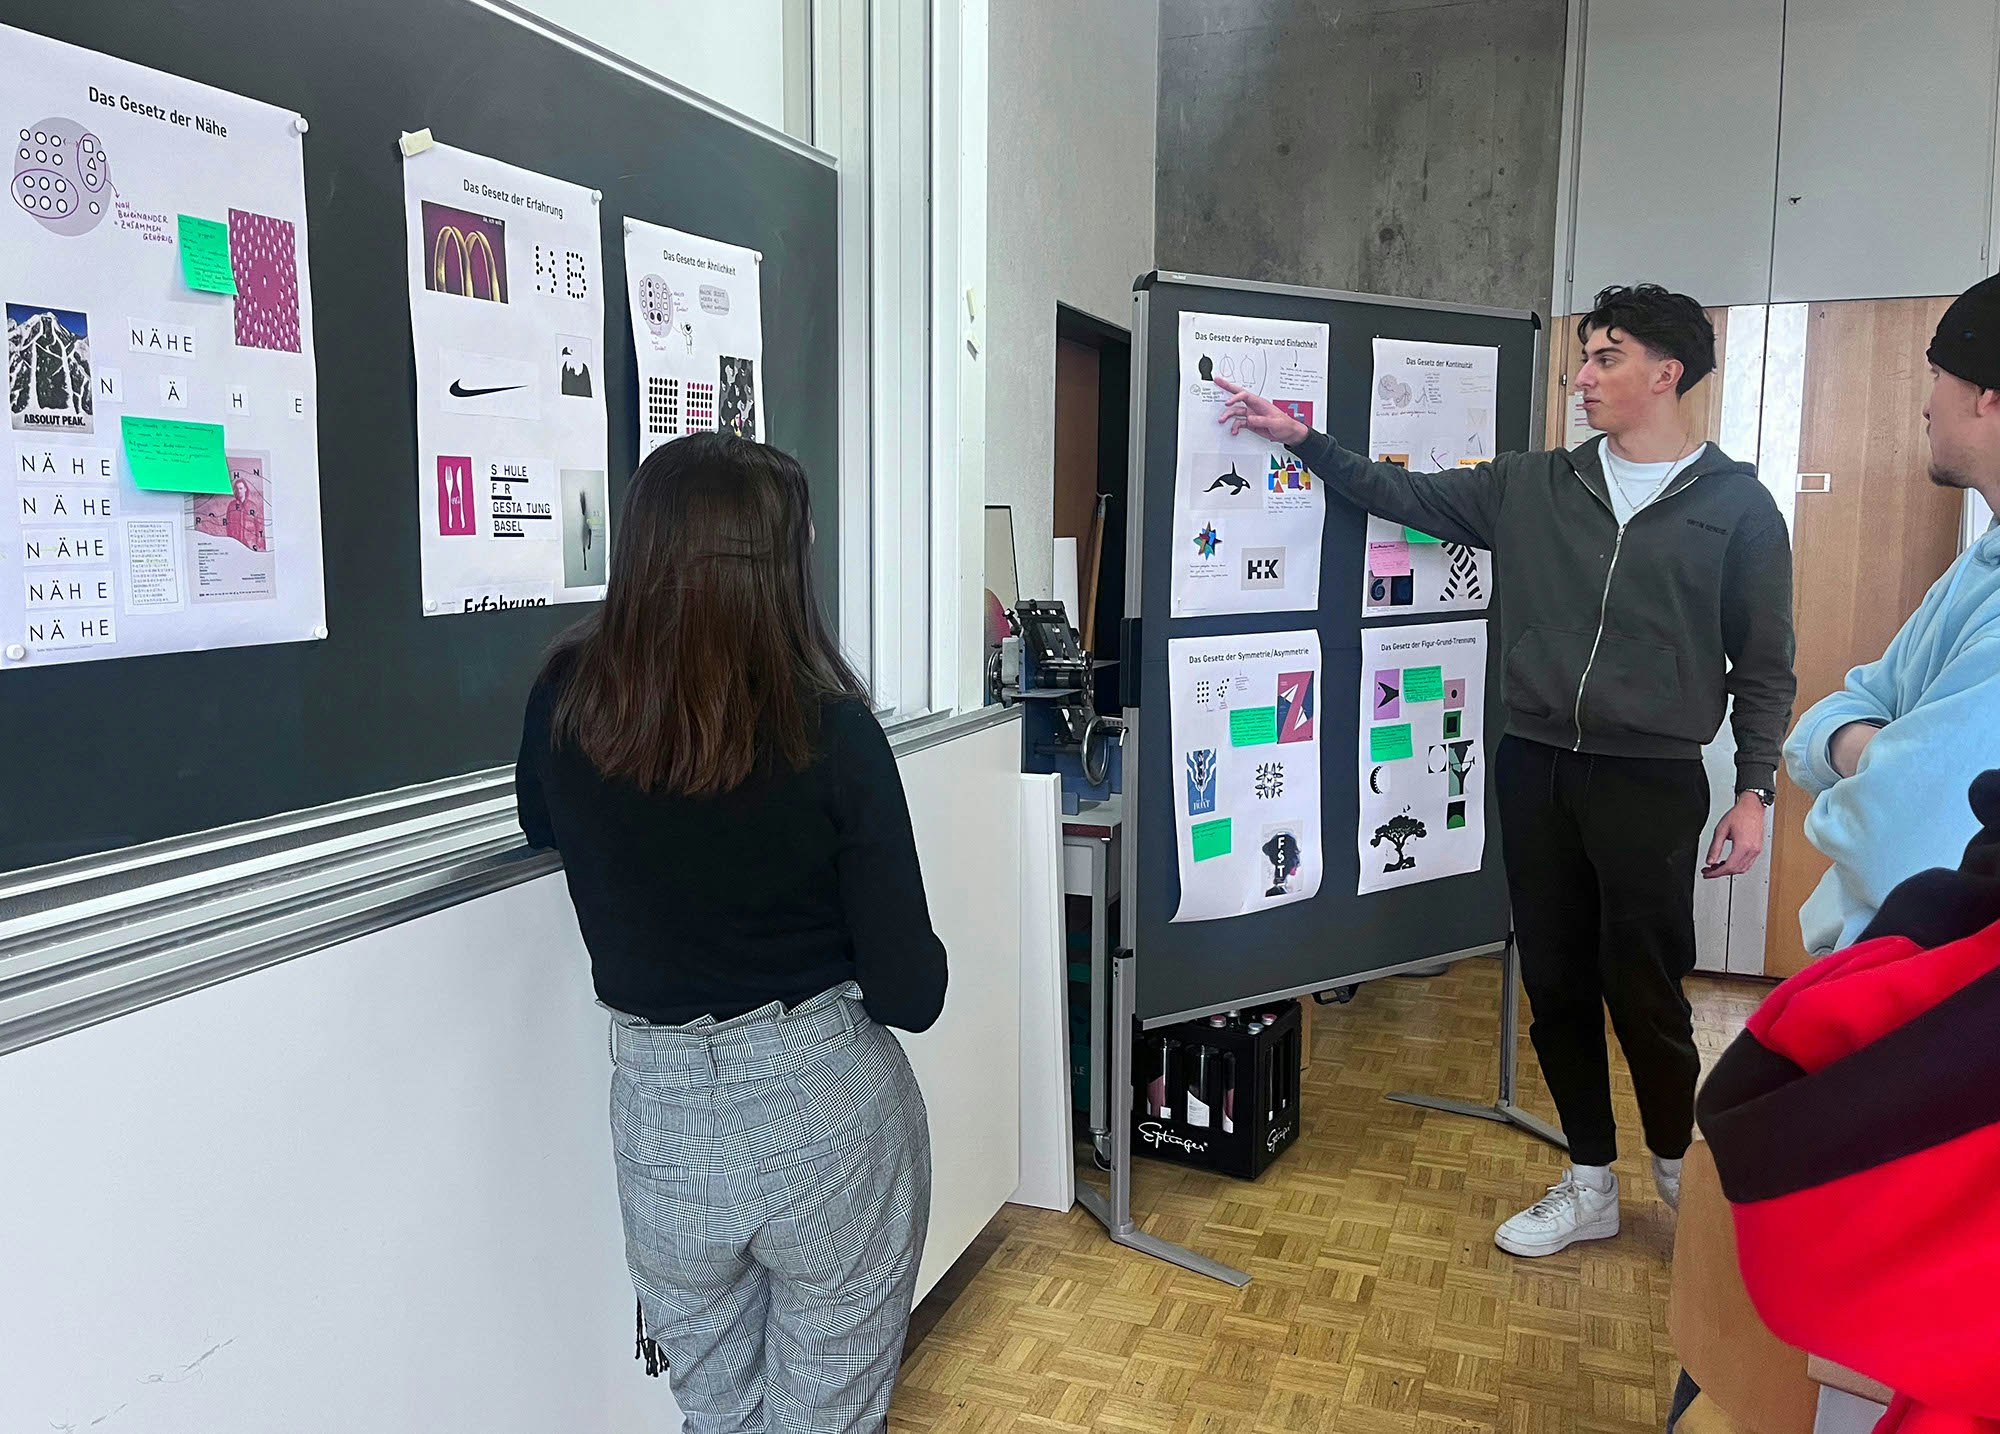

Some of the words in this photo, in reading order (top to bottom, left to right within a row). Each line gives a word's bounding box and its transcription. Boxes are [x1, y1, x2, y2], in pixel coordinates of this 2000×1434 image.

[89, 86, 115, 107] Das
[120, 95, 166, 121] Gesetz
[170, 110, 191, 127] der
[195, 116, 227, 138] Nähe
[463, 178, 480, 194] Das
[482, 184, 509, 202] Gesetz
[511, 193, 524, 206] der
[526, 197, 563, 219] Erfahrung
[663, 249, 675, 261] Das
[676, 252, 696, 266] Gesetz
[697, 258, 706, 268] der
[131, 328, 193, 353] NÄHE
[1195, 331, 1208, 341] Das
[1209, 333, 1231, 343] Gesetz
[1232, 335, 1243, 343] der
[1244, 335, 1273, 346] Prägnanz
[1274, 338, 1285, 347] und
[1286, 338, 1318, 348] Einfachheit
[1406, 357, 1416, 366] Das
[1417, 358, 1435, 367] Gesetz
[1436, 359, 1445, 367] der
[24, 414, 60, 425] ABSOLUT
[494, 520, 523, 532] BASEL
[1393, 642, 1410, 650] Gesetz
[1411, 641, 1420, 649] der
[1189, 655, 1201, 664] Das
[1203, 654, 1224, 663] Gesetz
[1225, 653, 1236, 661] der
[1238, 647, 1309, 661] Symmetrie/Asymmetrie
[1138, 1121, 1206, 1153] Eptinger
